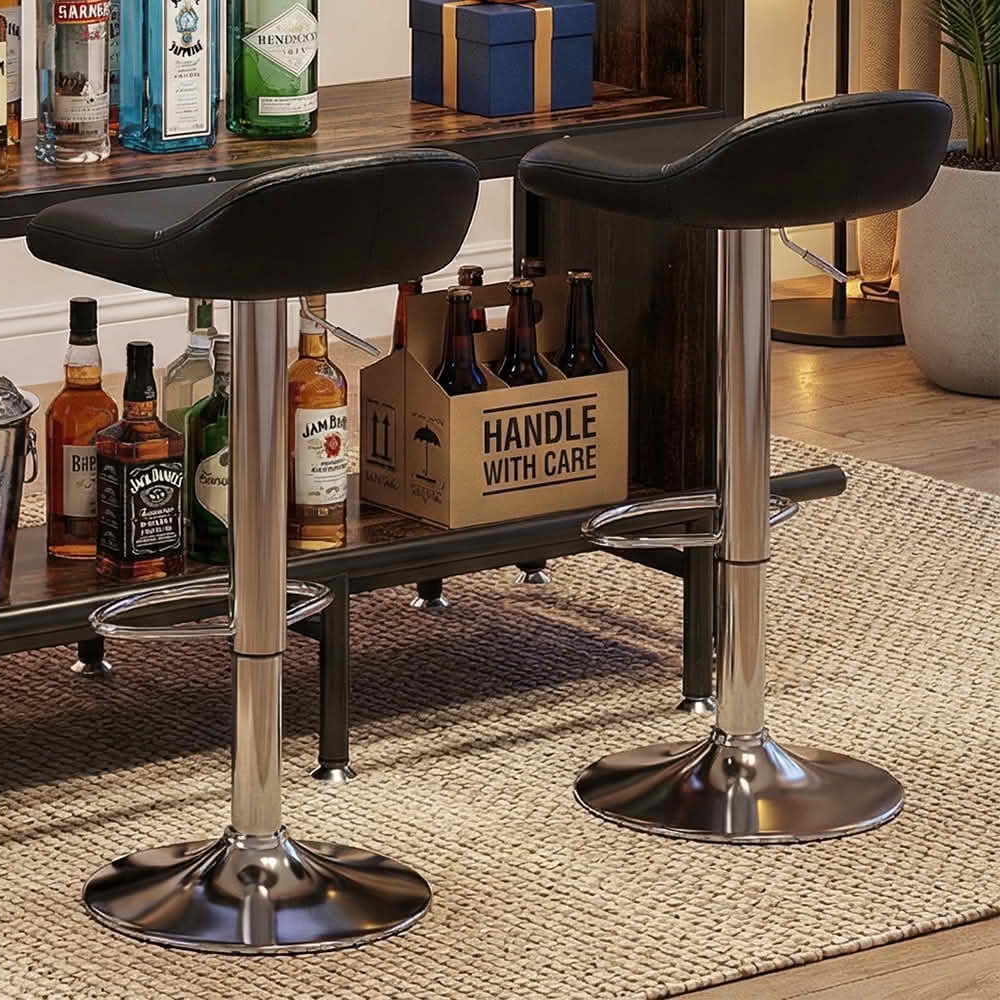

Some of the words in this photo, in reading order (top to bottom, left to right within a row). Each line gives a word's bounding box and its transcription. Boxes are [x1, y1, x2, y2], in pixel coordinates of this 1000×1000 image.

[484, 405, 597, 454] HANDLE
[483, 454, 536, 486] WITH
[544, 445, 597, 477] CARE
